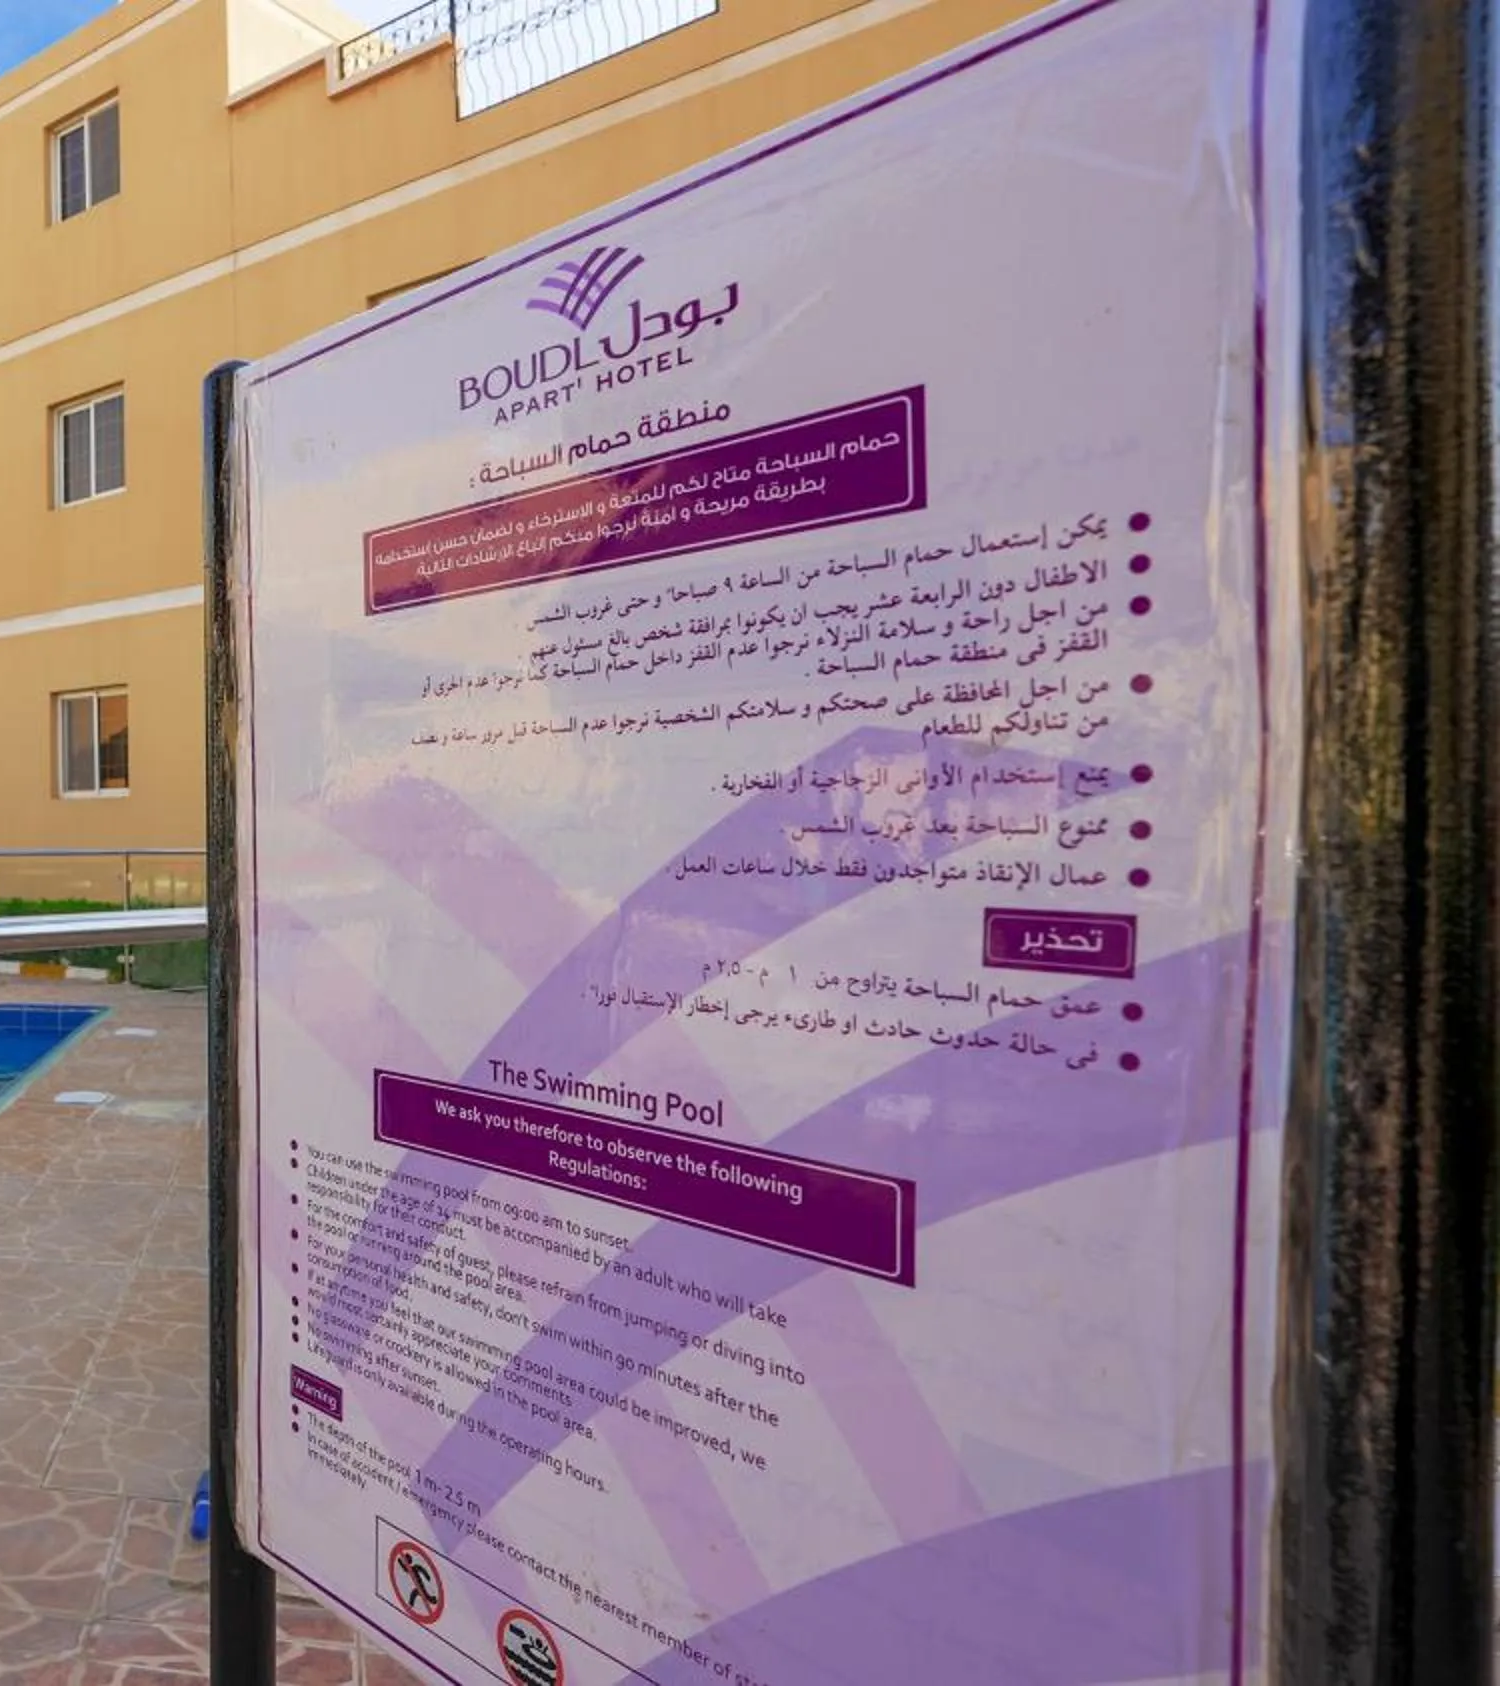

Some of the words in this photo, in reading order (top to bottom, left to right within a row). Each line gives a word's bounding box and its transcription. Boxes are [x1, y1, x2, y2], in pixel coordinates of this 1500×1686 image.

[599, 282, 739, 359] بودل
[459, 335, 598, 411] BOUDL
[494, 377, 585, 425] APART'
[596, 348, 693, 393] HOTEL
[638, 400, 731, 440] منطقة
[567, 430, 631, 464] حمام
[754, 476, 826, 504] بطريقة
[694, 494, 749, 518] مريحة
[792, 816, 854, 841] الشمس
[862, 817, 916, 841] غروب
[925, 816, 957, 840] بعد
[966, 816, 1048, 841] السباحة
[1058, 817, 1108, 848] ممنوع
[675, 856, 716, 880] العمل
[722, 858, 775, 876] ساعات
[781, 856, 826, 876] خلال
[835, 860, 867, 877] فقط
[874, 858, 967, 888] متواجدون
[1049, 863, 1107, 886] عمال
[1020, 928, 1103, 954] تحذير
[488, 1060, 528, 1088] The
[533, 1069, 658, 1120] Swimming
[666, 1093, 723, 1127] Pool
[435, 1099, 456, 1117] We
[460, 1104, 481, 1122] ask
[484, 1113, 510, 1129] you
[514, 1115, 583, 1147] therefore
[587, 1134, 603, 1151] to
[607, 1138, 672, 1169] observe
[677, 1154, 707, 1177] the
[710, 1160, 803, 1205] following
[549, 1151, 647, 1190] Regulations:
[444, 1184, 468, 1201] pool
[471, 1189, 500, 1211] from
[453, 1210, 483, 1228] must
[486, 1217, 500, 1234] be
[504, 1227, 589, 1263] accompanied
[594, 1255, 610, 1273] by
[613, 1262, 631, 1275] an
[635, 1268, 673, 1291] adult
[677, 1278, 710, 1303] who
[715, 1292, 743, 1313] will
[749, 1299, 787, 1328] take
[498, 1264, 537, 1289] please
[588, 1293, 621, 1317] from
[624, 1313, 688, 1348] jumping
[692, 1335, 708, 1350] or
[713, 1339, 765, 1376] diving
[769, 1358, 805, 1385] into
[532, 1321, 567, 1343] swim
[569, 1335, 614, 1360] within
[616, 1354, 634, 1371] 90
[638, 1362, 700, 1397] minutes
[705, 1387, 745, 1412] after
[748, 1403, 779, 1427] the
[524, 1359, 553, 1381] pool
[556, 1373, 585, 1394] area
[589, 1386, 628, 1412] could
[632, 1401, 650, 1421] be
[654, 1410, 736, 1461] improved,
[741, 1448, 768, 1470] we
[466, 1523, 504, 1551] please
[508, 1547, 557, 1582] contact
[559, 1573, 581, 1594] the
[584, 1588, 639, 1629] nearest
[641, 1619, 709, 1666] member
[713, 1664, 730, 1679] of
